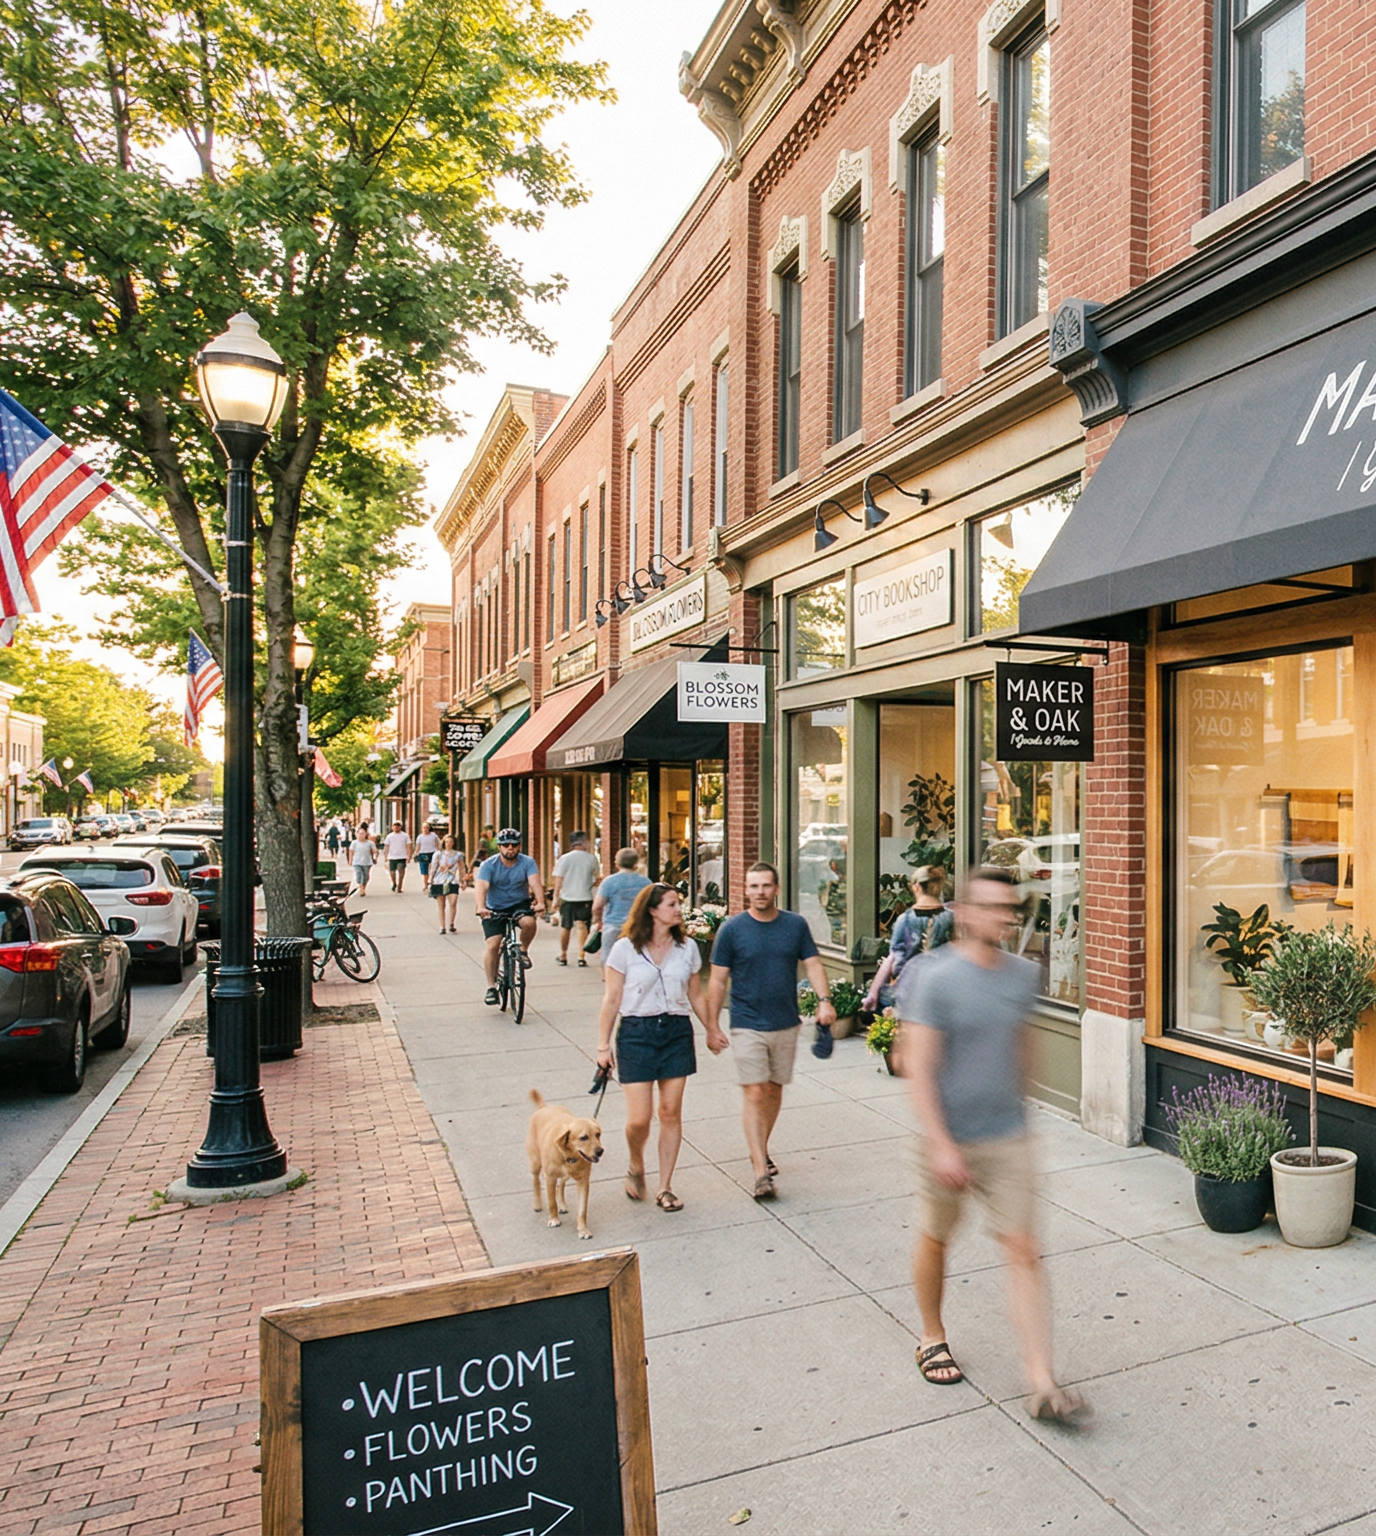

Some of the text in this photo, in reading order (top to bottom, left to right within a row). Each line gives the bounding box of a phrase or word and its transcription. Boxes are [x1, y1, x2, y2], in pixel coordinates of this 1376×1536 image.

[858, 565, 945, 616] CITY BOOKSHOP
[685, 680, 759, 695] BLOSSOM
[1007, 677, 1084, 704] MAKER
[686, 695, 758, 709] FLOWERS
[1010, 707, 1081, 732] & OAK
